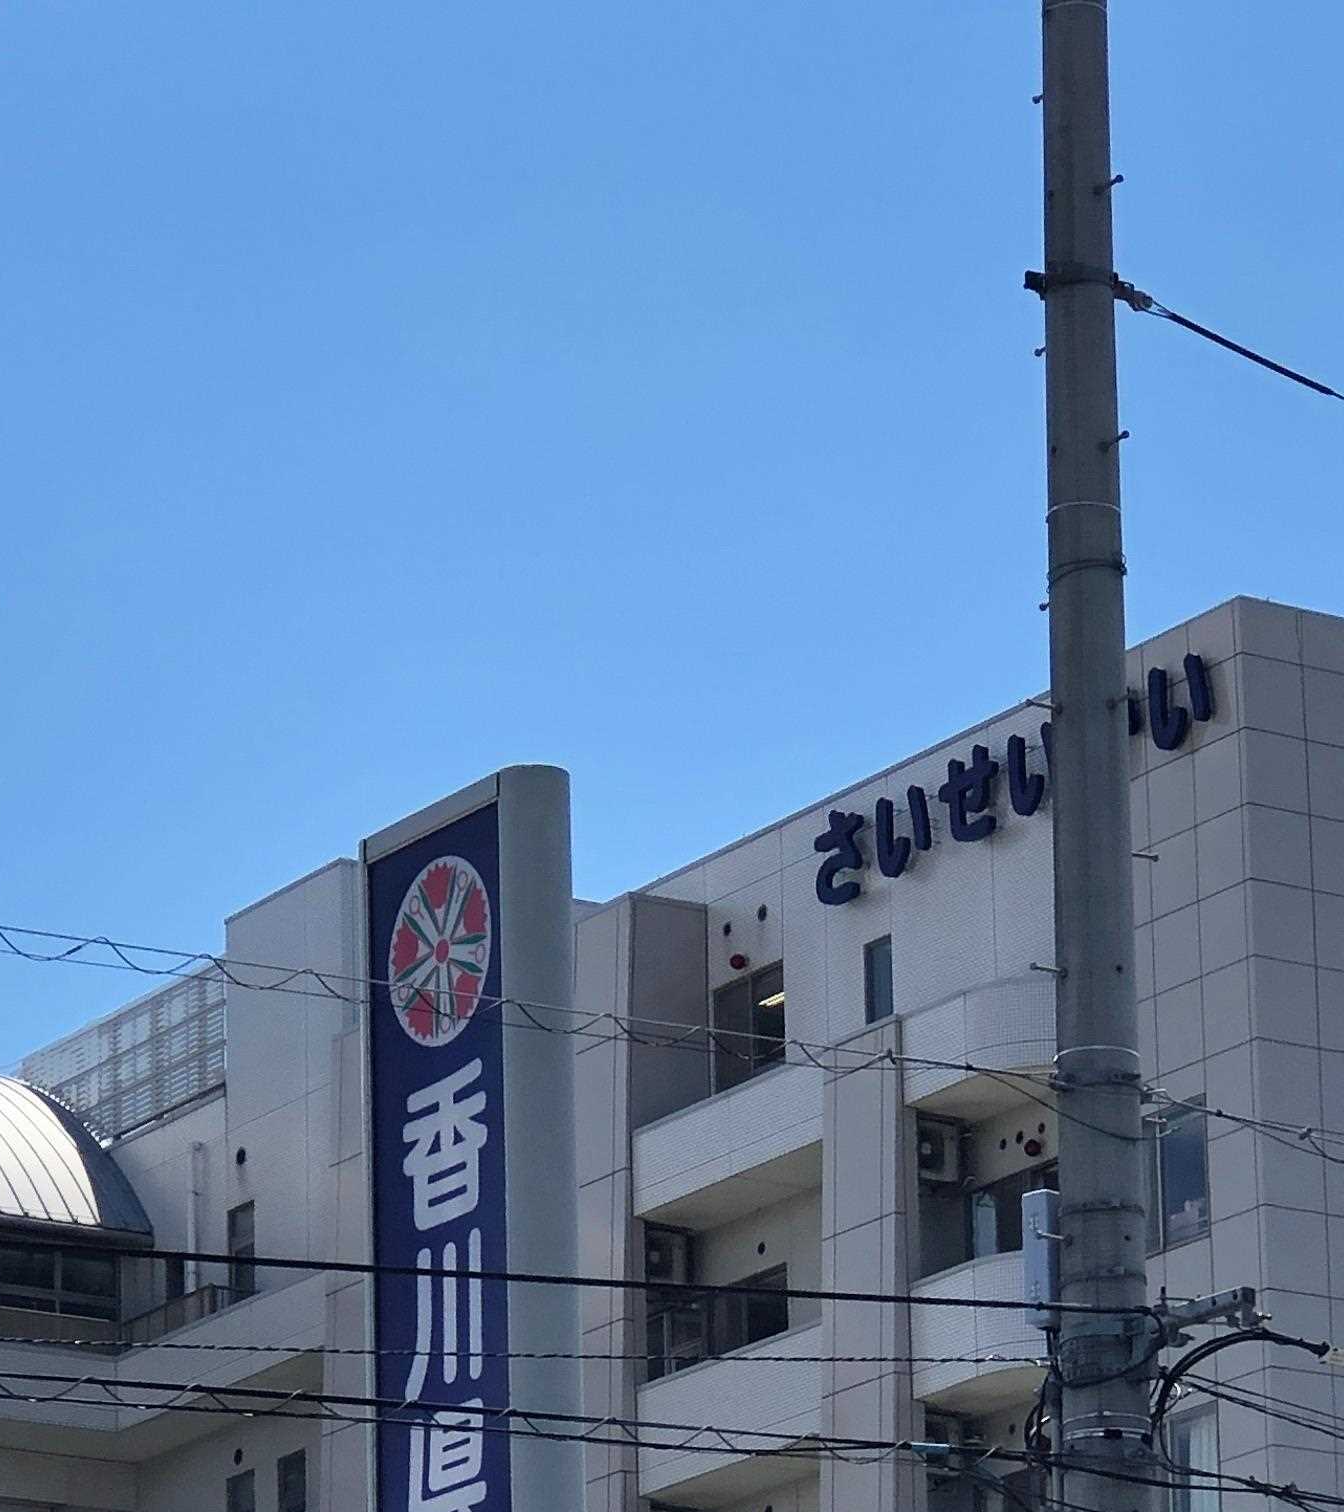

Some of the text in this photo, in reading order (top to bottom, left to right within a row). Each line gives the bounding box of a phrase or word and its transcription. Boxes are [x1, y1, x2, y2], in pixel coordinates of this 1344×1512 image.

[813, 651, 1214, 906] さいせいい
